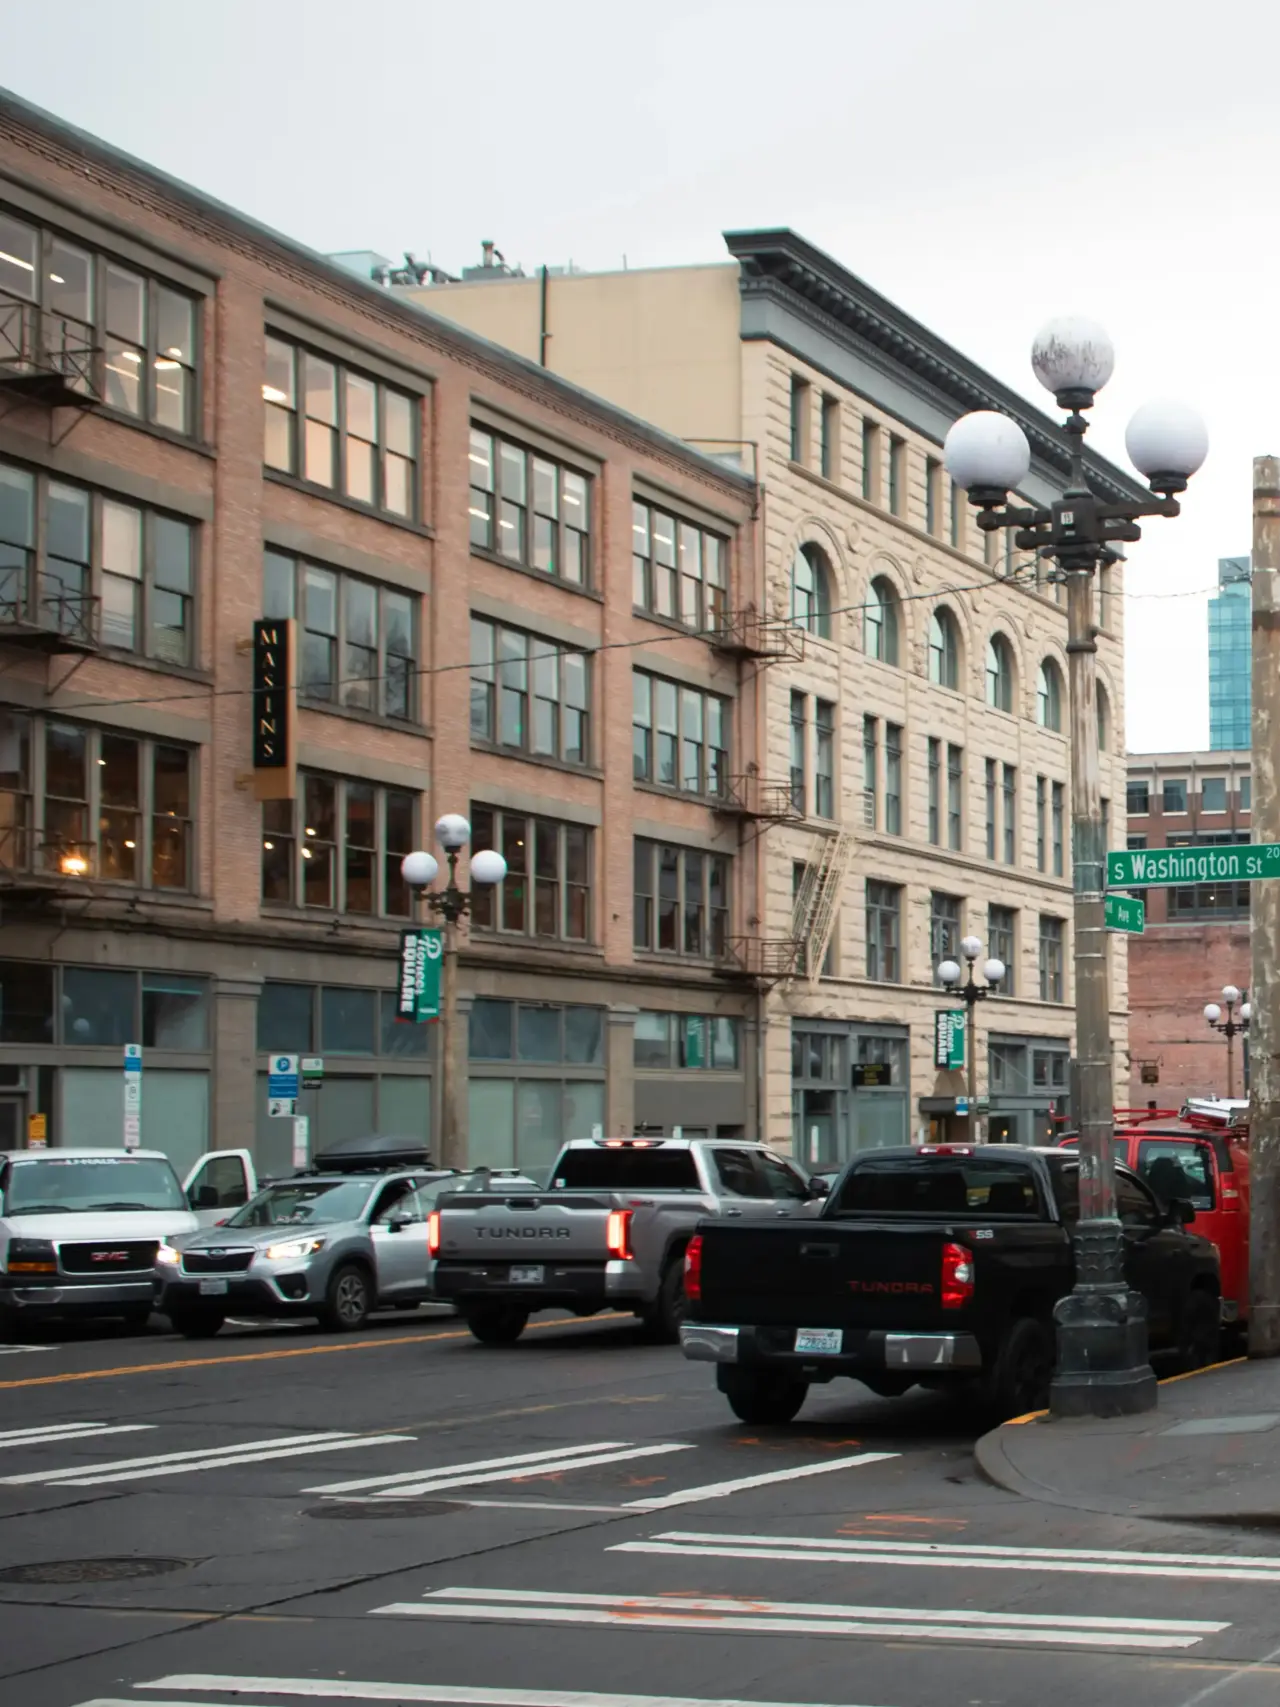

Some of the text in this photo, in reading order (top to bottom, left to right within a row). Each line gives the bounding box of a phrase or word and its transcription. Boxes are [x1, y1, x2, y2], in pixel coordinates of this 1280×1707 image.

[259, 628, 278, 758] MASINS
[1114, 862, 1125, 880] S
[1131, 851, 1239, 881] Washington
[1246, 856, 1263, 874] St
[1118, 905, 1129, 923] Ave
[1136, 909, 1142, 926] S
[400, 935, 417, 1012] SQUARE
[937, 1013, 947, 1064] SQUARE
[474, 1226, 571, 1240] TUNDRA
[847, 1280, 935, 1294] TUNDRA
